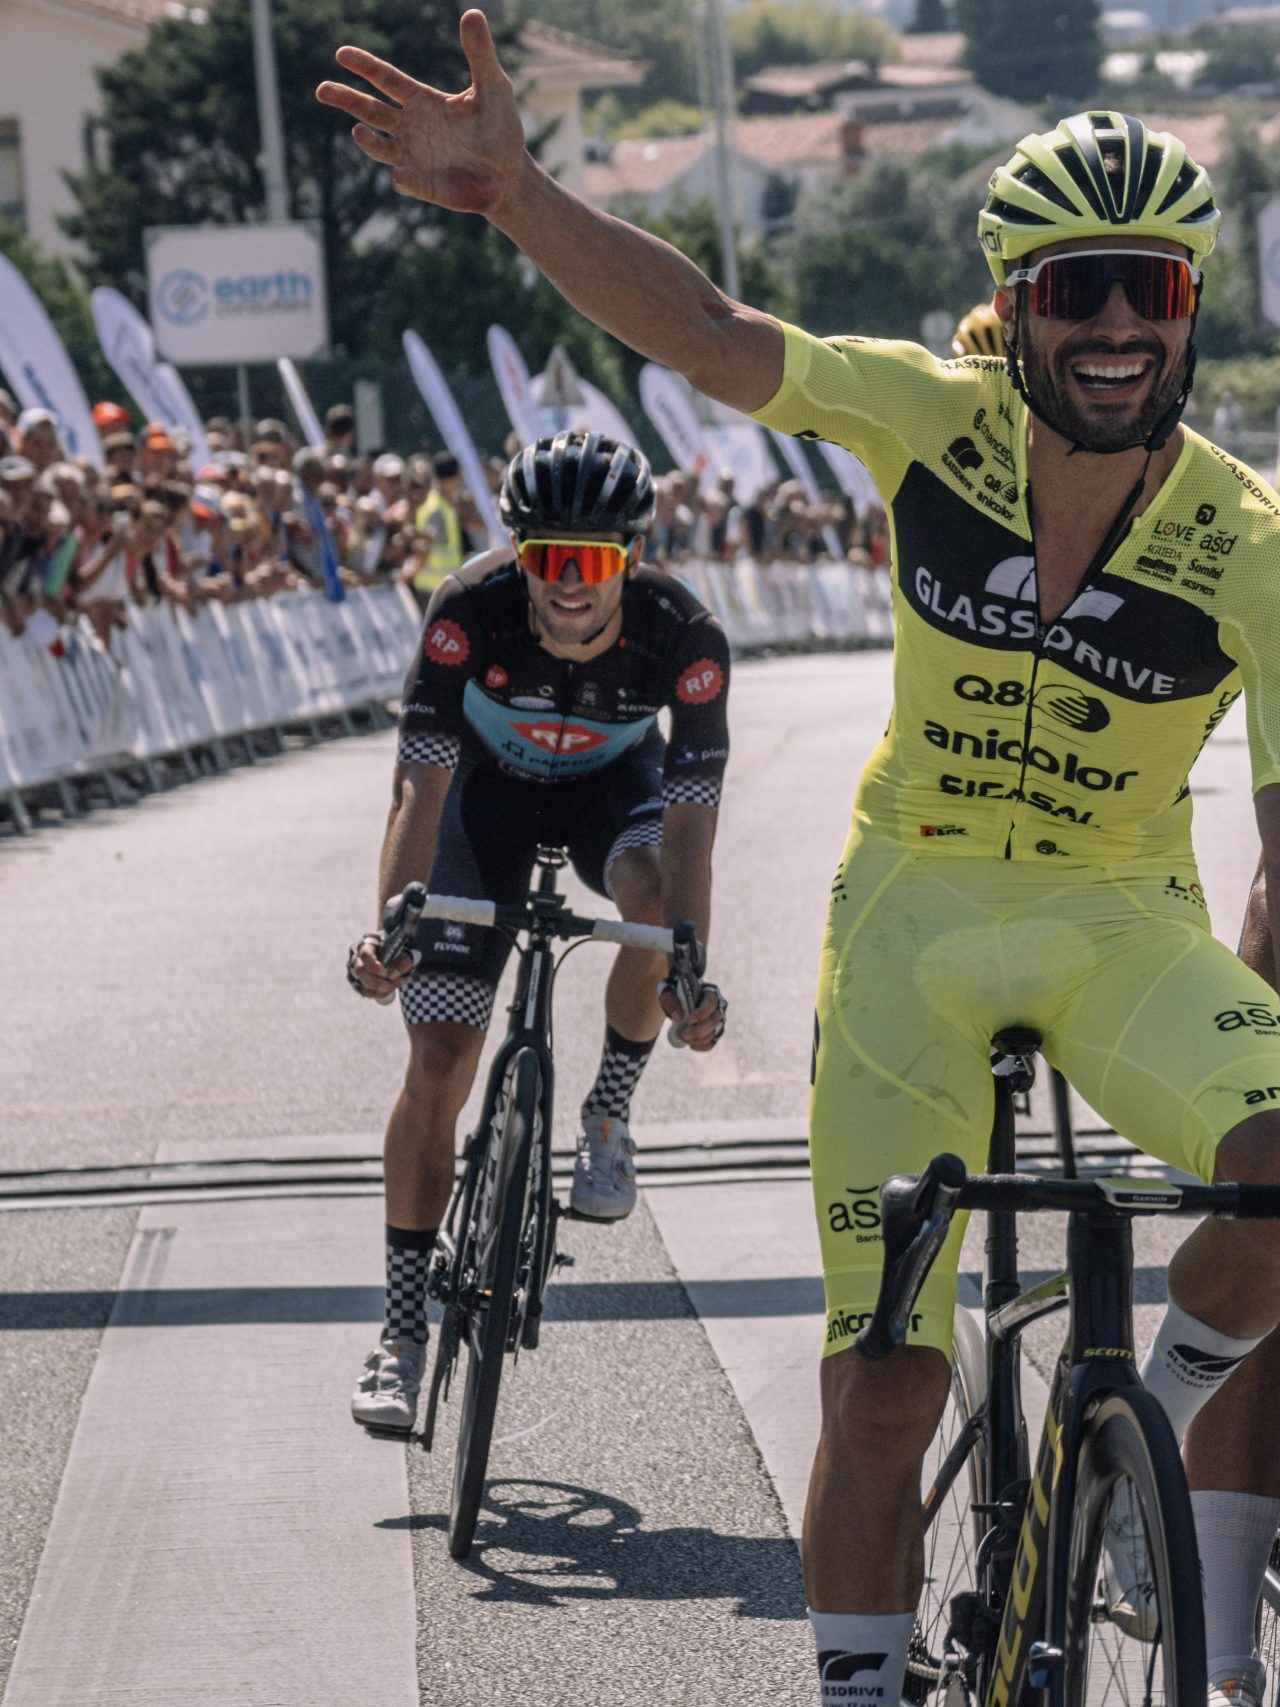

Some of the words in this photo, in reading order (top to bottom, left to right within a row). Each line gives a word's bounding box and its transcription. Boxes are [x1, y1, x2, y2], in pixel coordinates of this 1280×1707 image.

[213, 269, 313, 301] earth
[984, 473, 1001, 493] Q8
[976, 490, 1015, 520] anicolor
[1153, 519, 1196, 542] LOVE
[430, 628, 459, 653] RP
[915, 566, 1175, 695] GLASSDRIVE
[686, 669, 715, 694] RP
[953, 674, 1025, 707] Q8
[531, 729, 590, 750] RP
[923, 719, 1139, 792] anicolor
